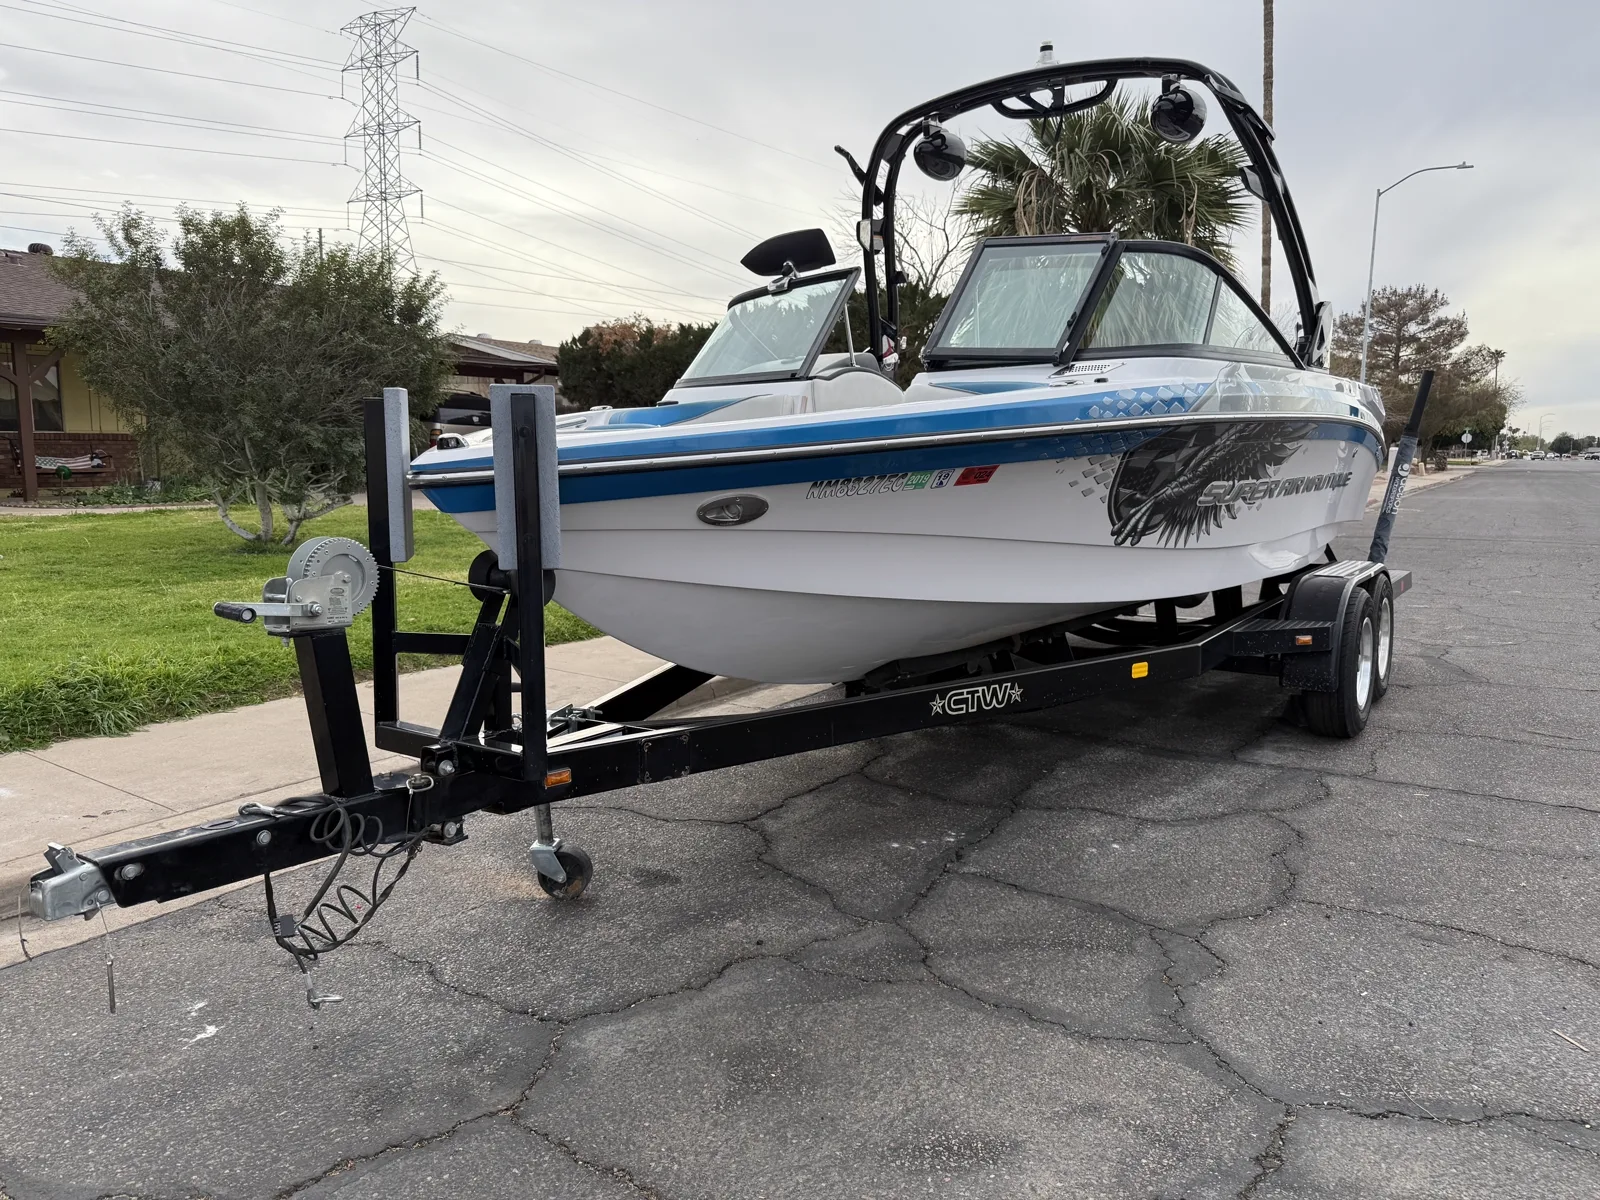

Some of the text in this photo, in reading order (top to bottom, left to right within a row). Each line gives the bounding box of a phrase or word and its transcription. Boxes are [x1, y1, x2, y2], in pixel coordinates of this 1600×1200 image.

[907, 473, 931, 485] 2019
[937, 472, 949, 482] 19
[1197, 478, 1280, 506] SUPER
[1276, 476, 1304, 499] AIR
[1391, 477, 1407, 515] action
[945, 682, 1011, 715] CTW
